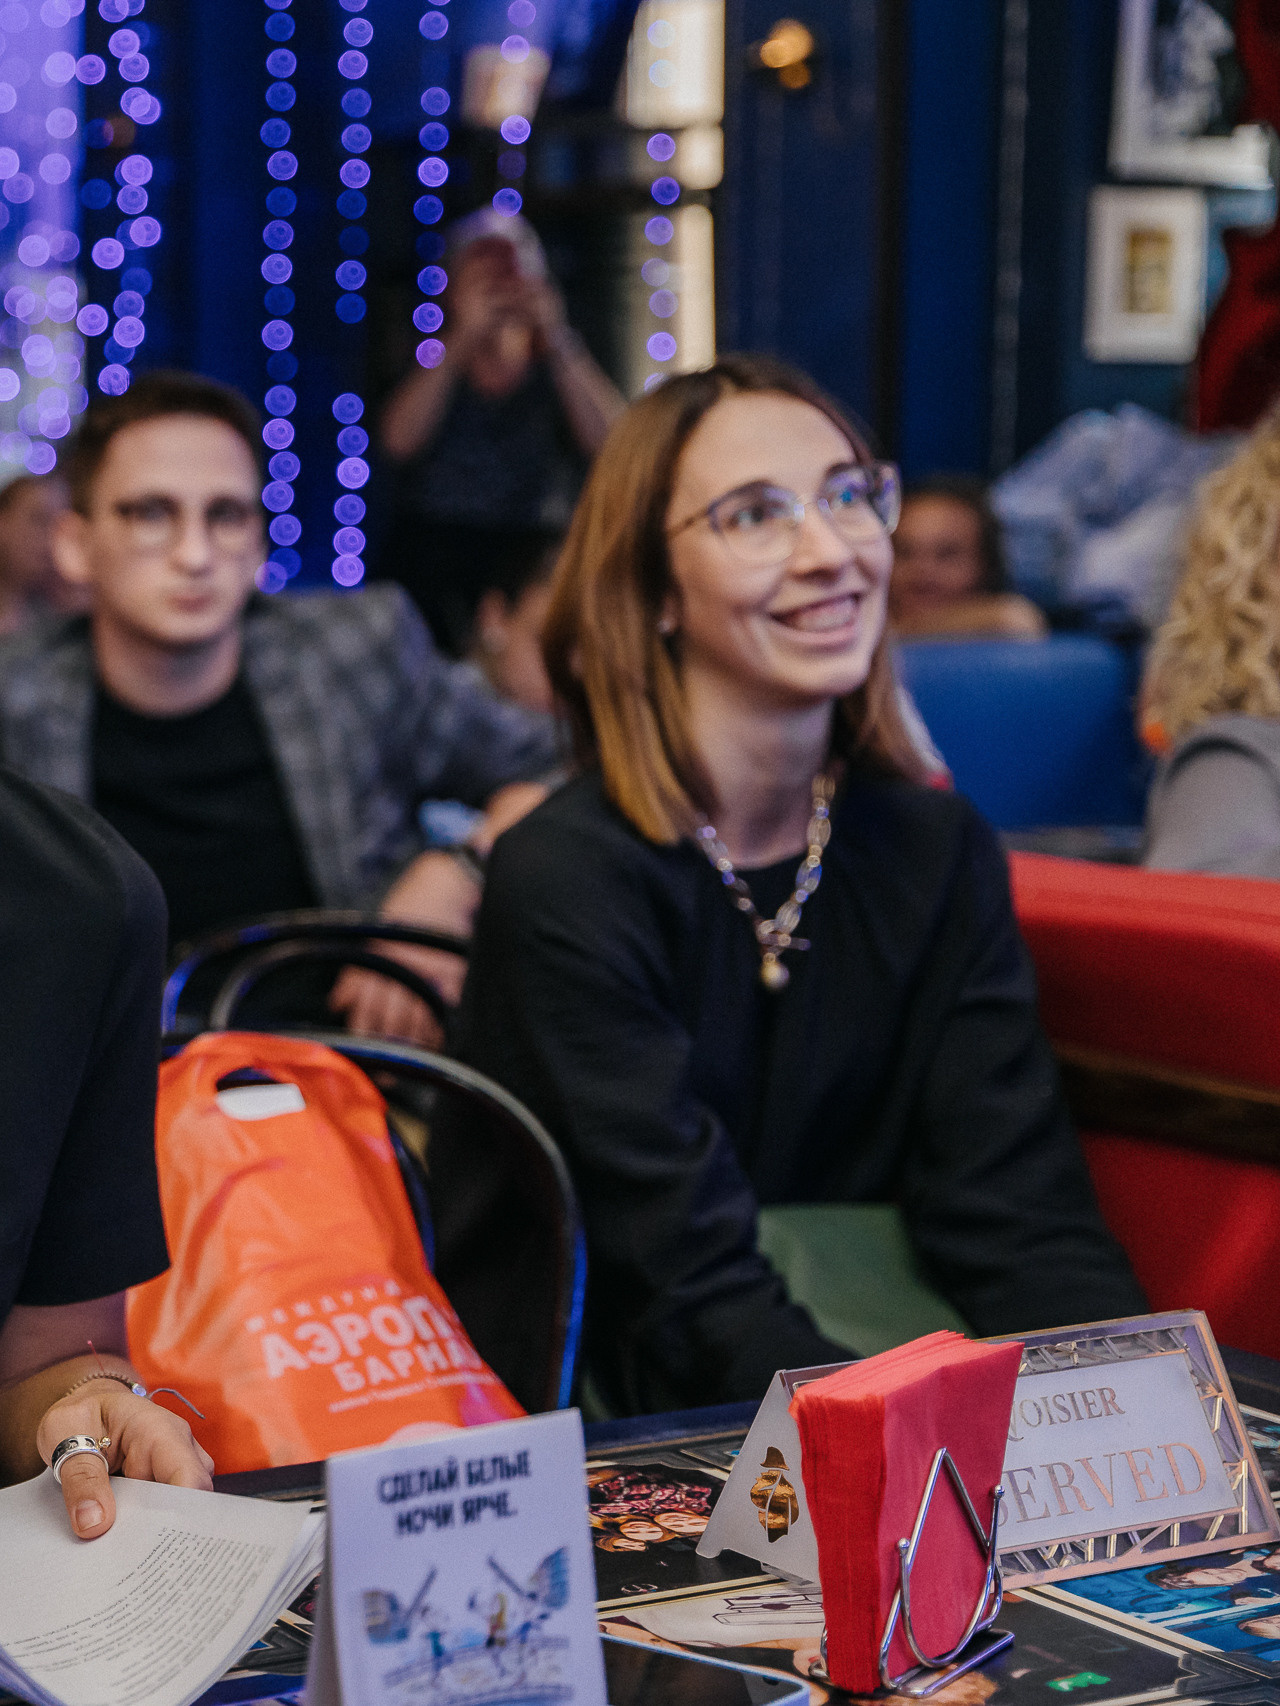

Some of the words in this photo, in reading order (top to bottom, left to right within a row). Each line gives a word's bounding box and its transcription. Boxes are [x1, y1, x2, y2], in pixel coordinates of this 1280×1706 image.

[260, 1294, 458, 1380] АЭРОП
[377, 1455, 458, 1503] СДЕЛАЙ
[465, 1450, 531, 1486] БЕЛЫЕ
[396, 1503, 455, 1535] НОЧИ
